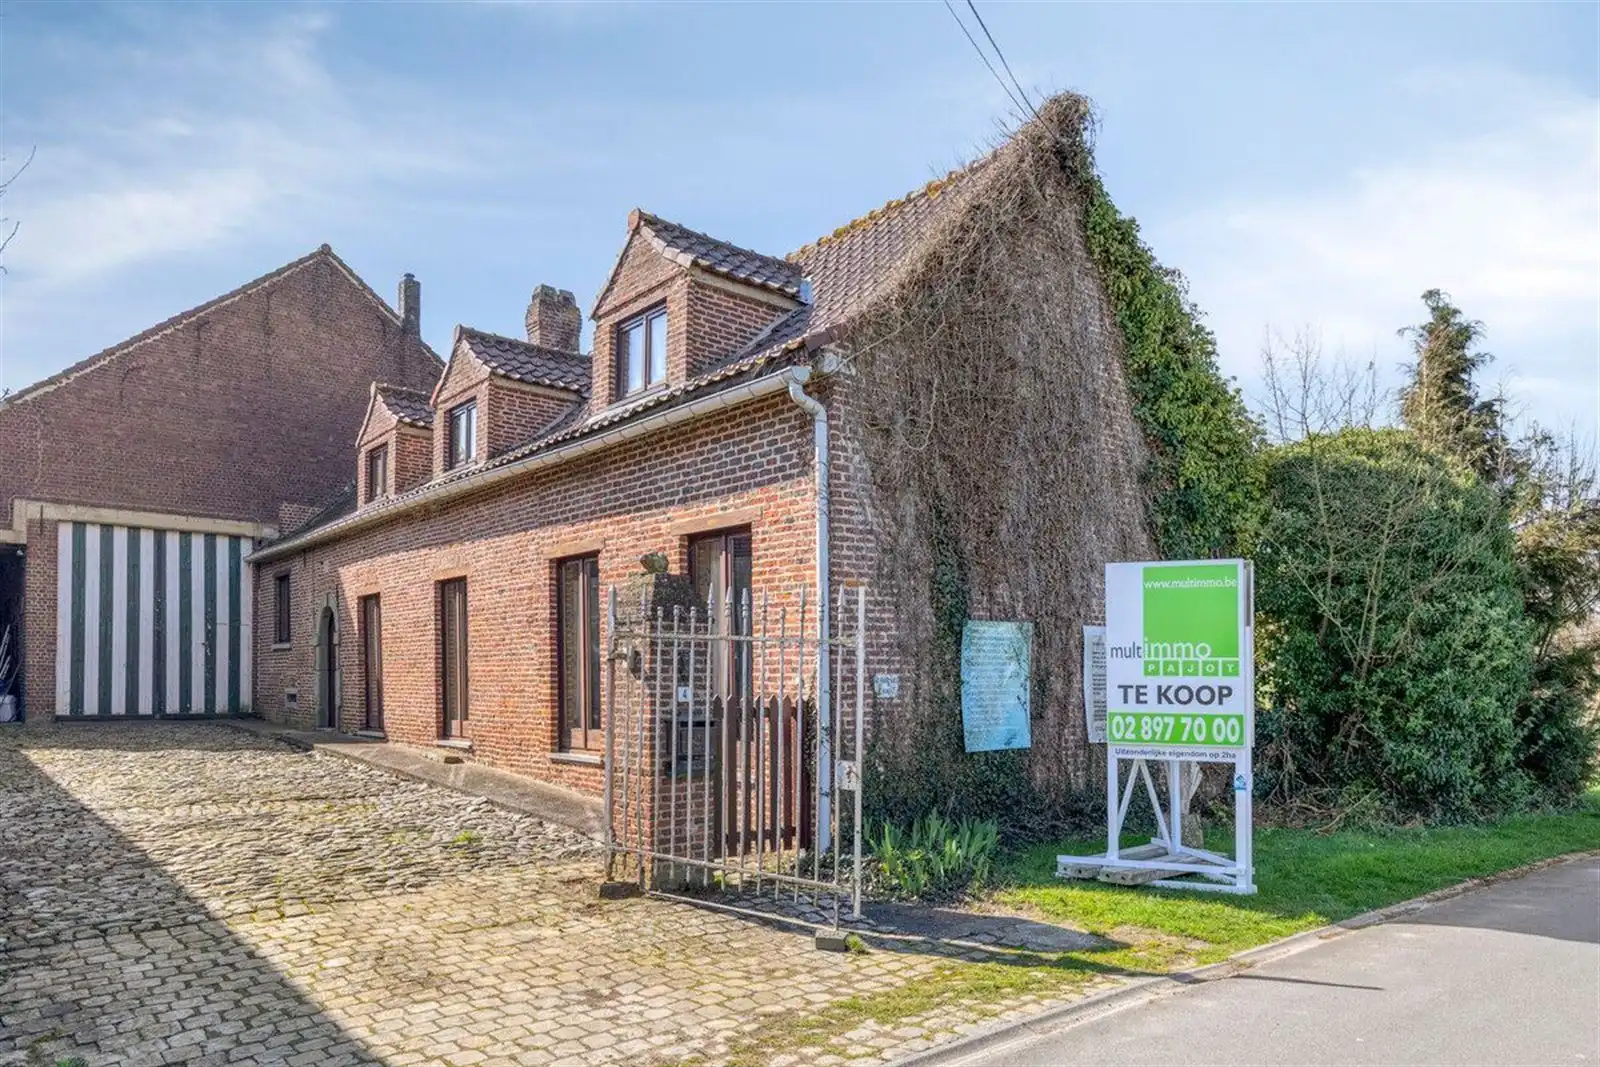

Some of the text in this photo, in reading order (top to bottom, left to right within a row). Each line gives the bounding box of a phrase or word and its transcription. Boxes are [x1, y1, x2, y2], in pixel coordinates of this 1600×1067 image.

[1110, 638, 1212, 659] multimmo
[1117, 684, 1233, 705] TE KOOP
[1111, 715, 1240, 743] 02 897 70 00
